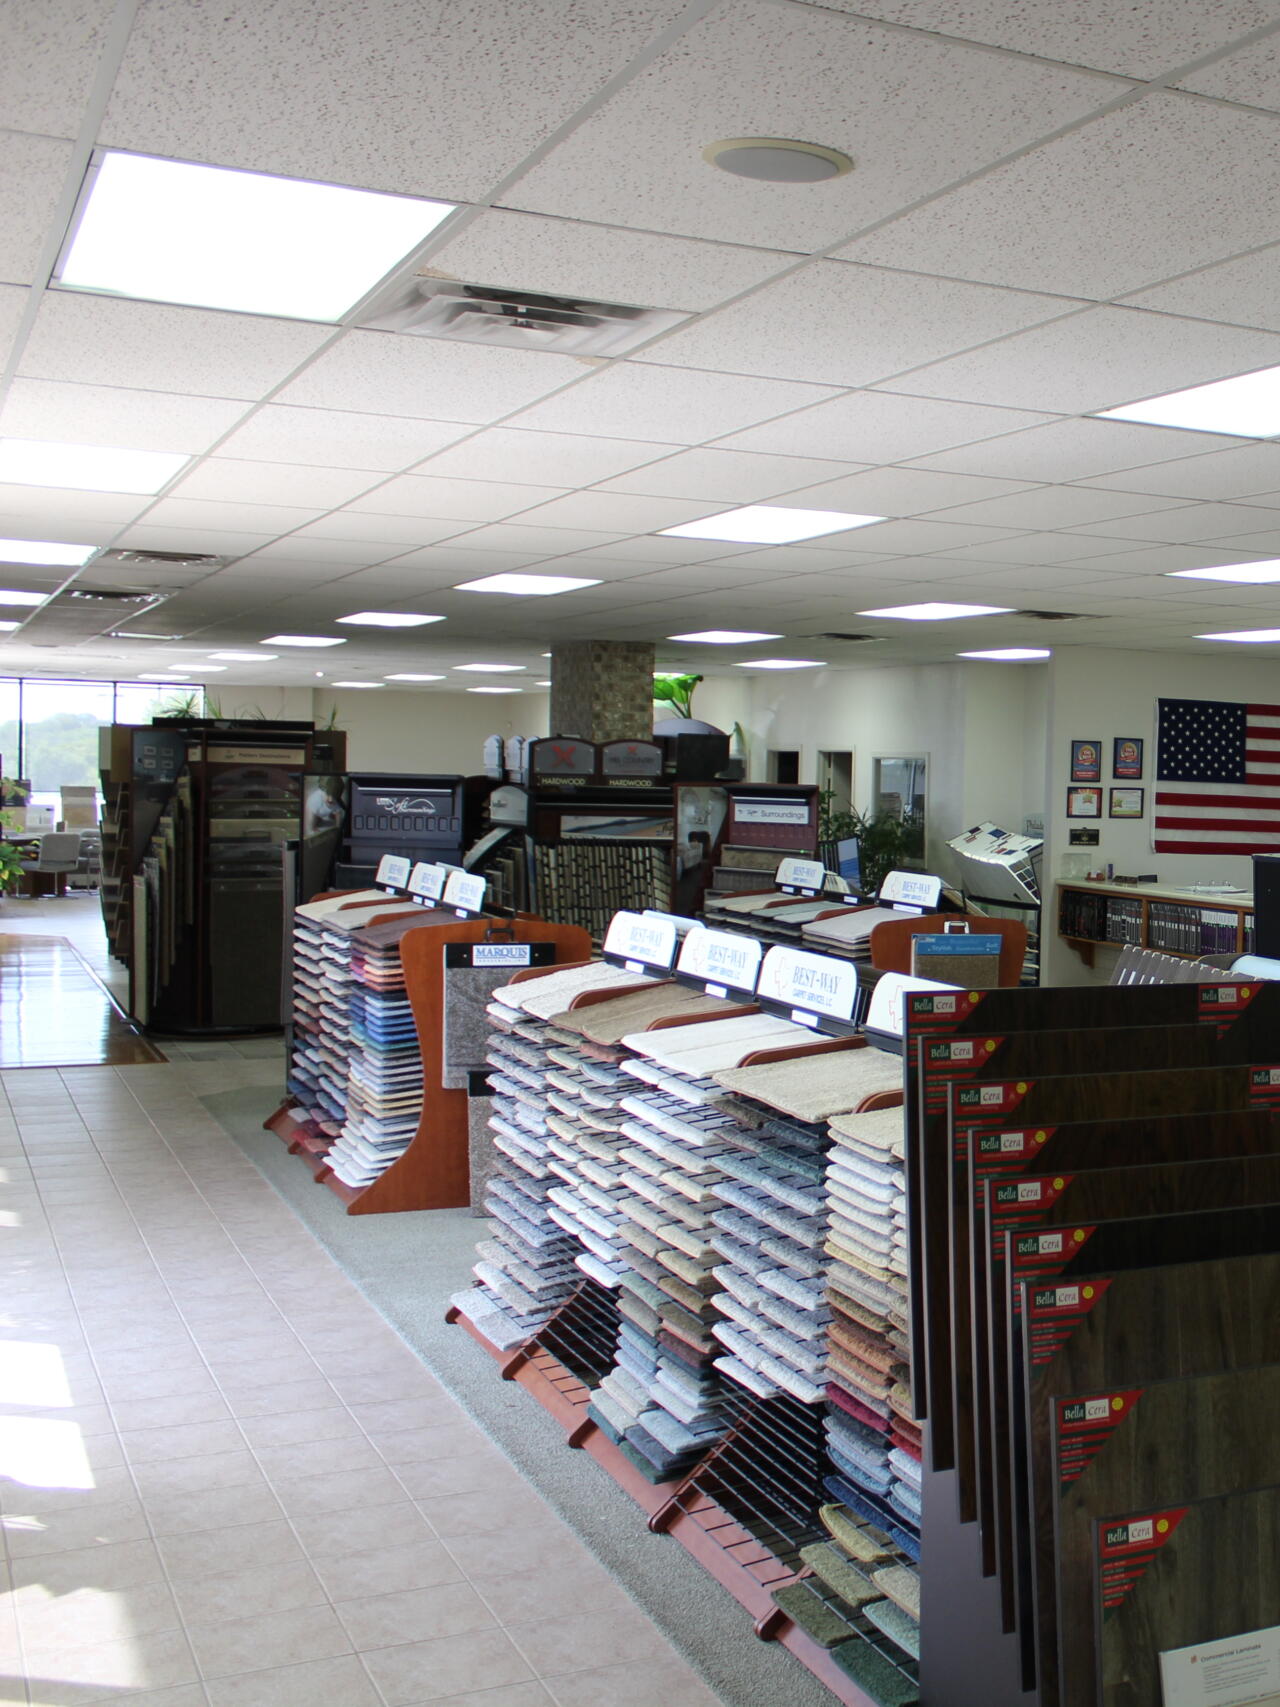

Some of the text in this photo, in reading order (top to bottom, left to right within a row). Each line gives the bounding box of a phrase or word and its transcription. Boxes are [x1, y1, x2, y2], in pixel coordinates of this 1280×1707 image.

[542, 777, 586, 786] HARDWOOD
[609, 779, 652, 787] HARDWOOD
[475, 946, 528, 958] MARQUIS
[707, 943, 752, 969] BEST-WAY
[792, 965, 842, 995] BEST-WAY
[913, 998, 955, 1012] Bella Cera
[930, 1043, 950, 1059] Bella
[960, 1090, 980, 1103] Bella
[980, 1135, 1000, 1150] Bella
[997, 1184, 1017, 1200] Bella
[1018, 1236, 1038, 1253] Bella
[1035, 1289, 1078, 1305] Bella Cera
[1064, 1404, 1107, 1421] Bella Cera
[1106, 1524, 1152, 1545] Bella Cera
[1200, 1650, 1235, 1663] Commercial
